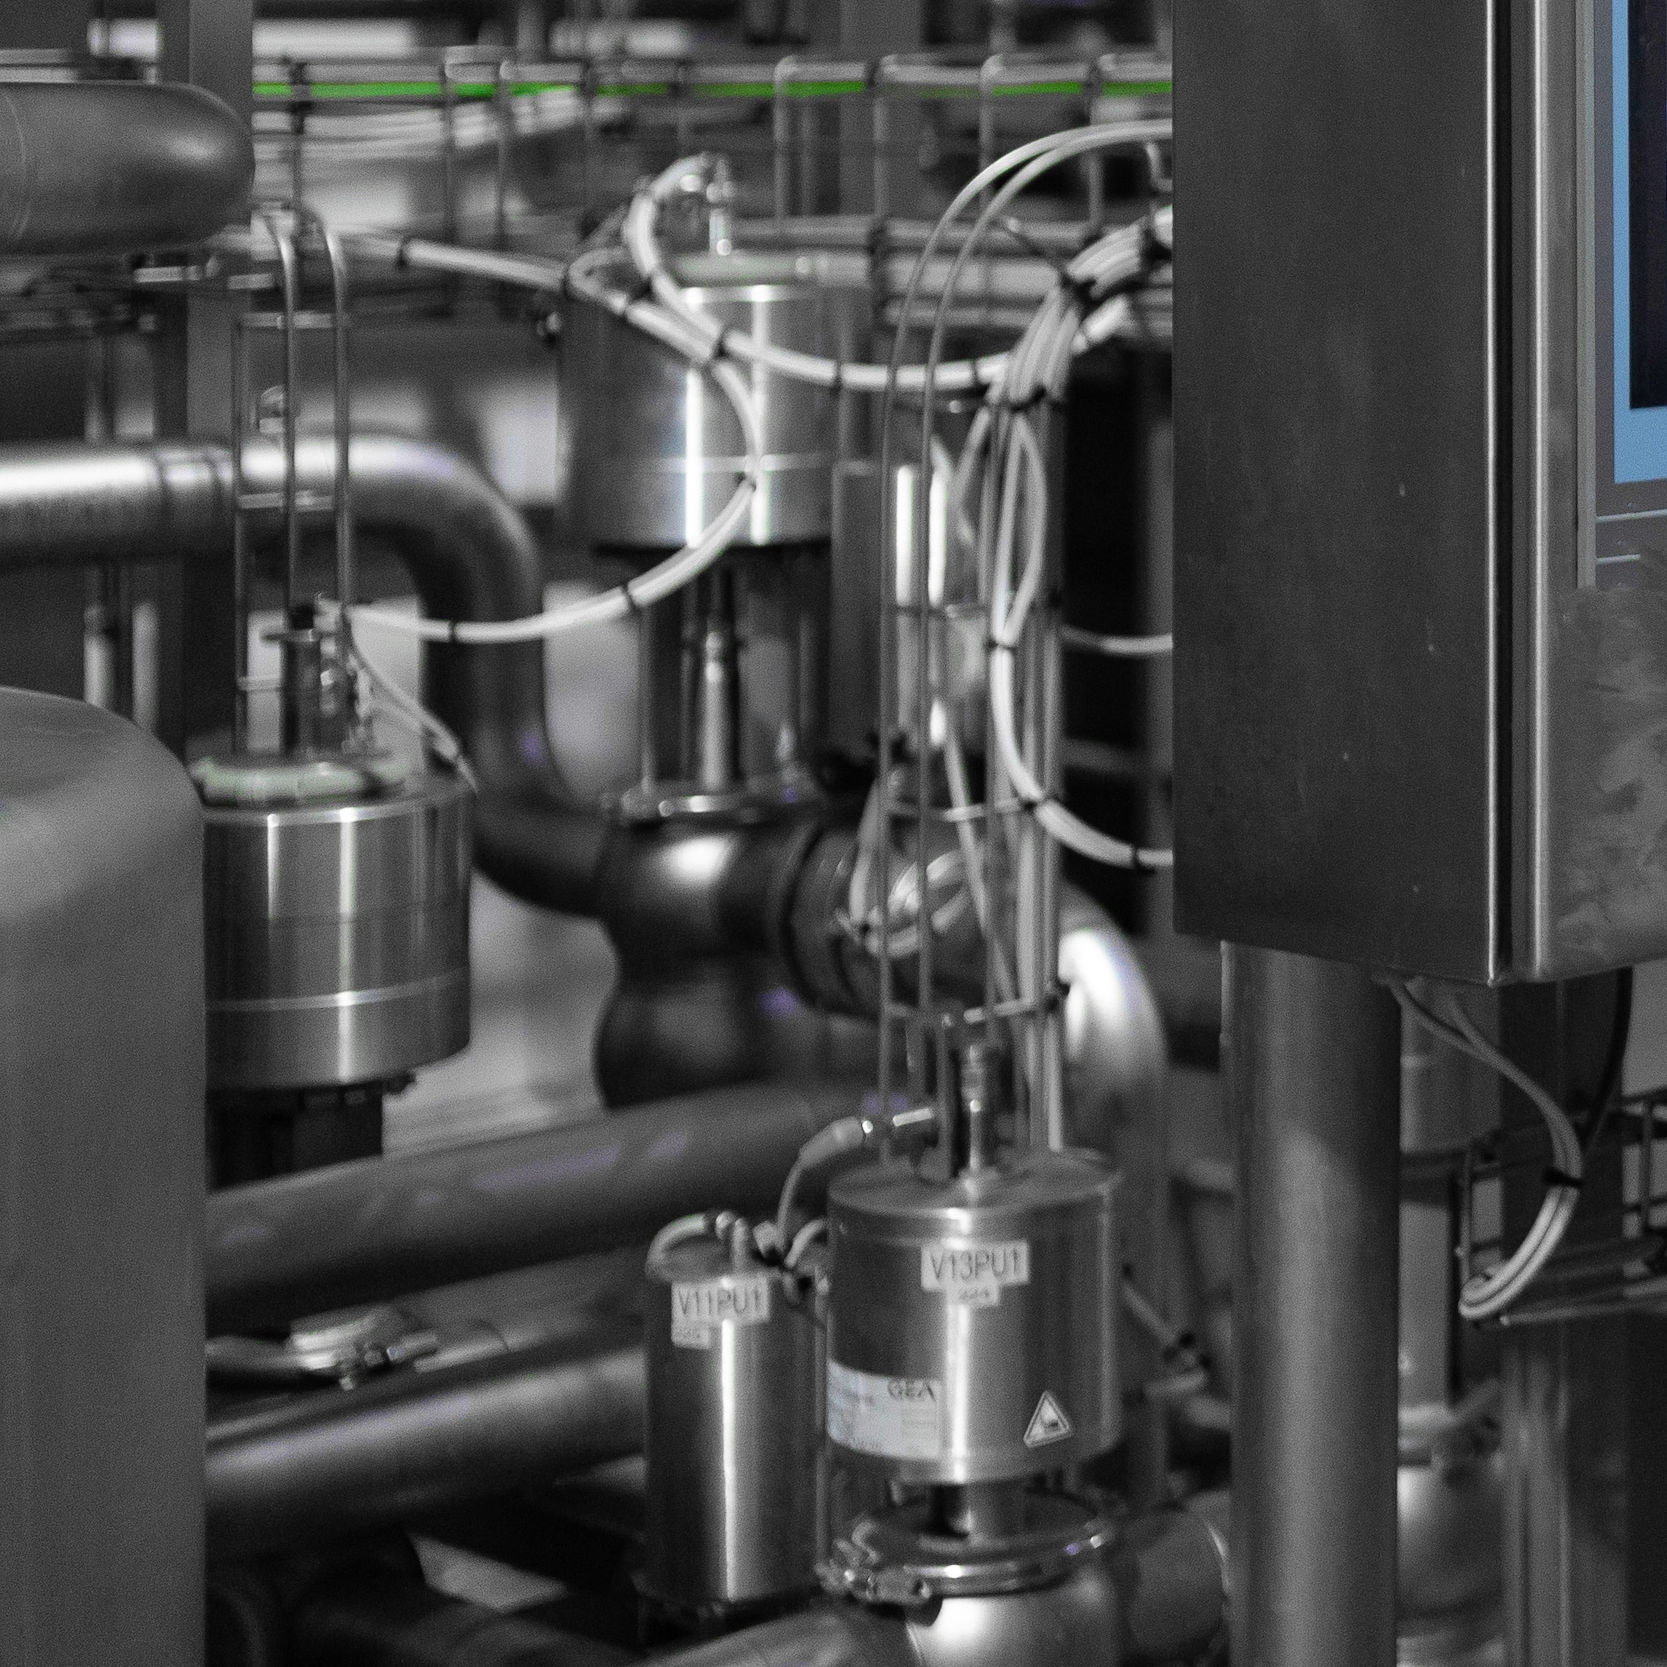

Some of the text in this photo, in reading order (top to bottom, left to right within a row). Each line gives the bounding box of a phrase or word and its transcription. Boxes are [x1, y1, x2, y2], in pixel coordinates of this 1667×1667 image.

[928, 1246, 1019, 1282] V13PU1
[678, 1285, 760, 1317] V11PU1
[887, 1377, 937, 1402] GEA
